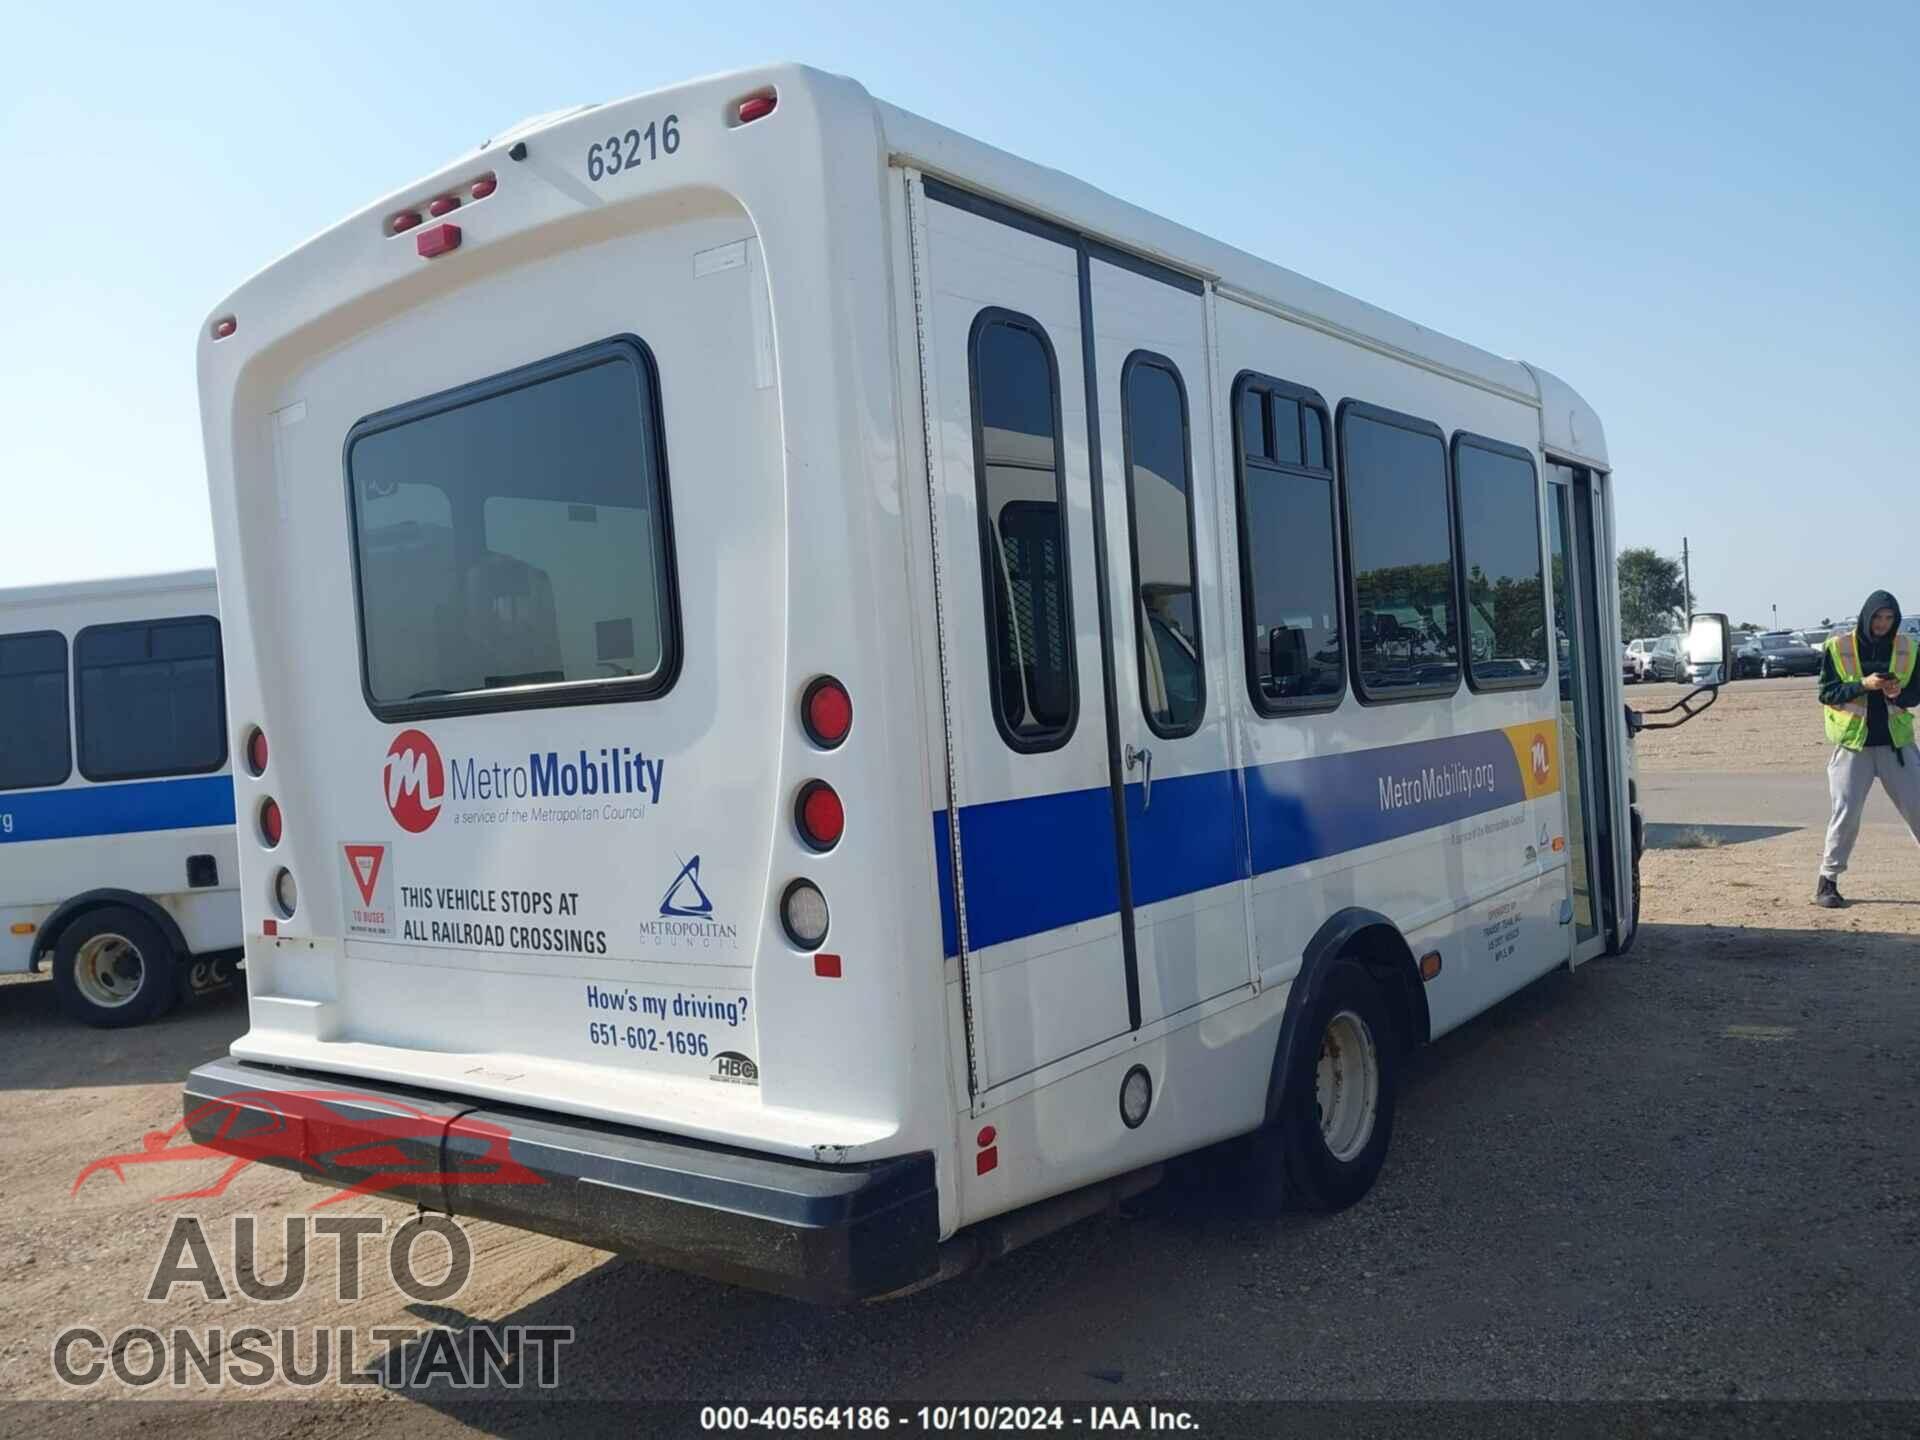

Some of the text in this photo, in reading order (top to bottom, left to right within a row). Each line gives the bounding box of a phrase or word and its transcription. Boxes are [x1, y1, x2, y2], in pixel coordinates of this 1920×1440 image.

[588, 114, 680, 181] 63216
[452, 747, 664, 804] MetroMobility
[1378, 762, 1494, 811] MetroMobility.org
[462, 811, 497, 824] service
[499, 809, 511, 823] of
[512, 809, 528, 823] the
[531, 806, 599, 824] Metropolitan
[602, 805, 645, 820] Council
[401, 887, 579, 915] THIS VEHICLE STOPS AT
[404, 920, 428, 941] ALL
[432, 921, 504, 946] RAILROAD
[510, 926, 607, 954] CROSSINGS
[640, 921, 736, 938] METROPOLITAN
[587, 985, 748, 1027] How's my driving?
[590, 1022, 709, 1057] 651-602-1696
